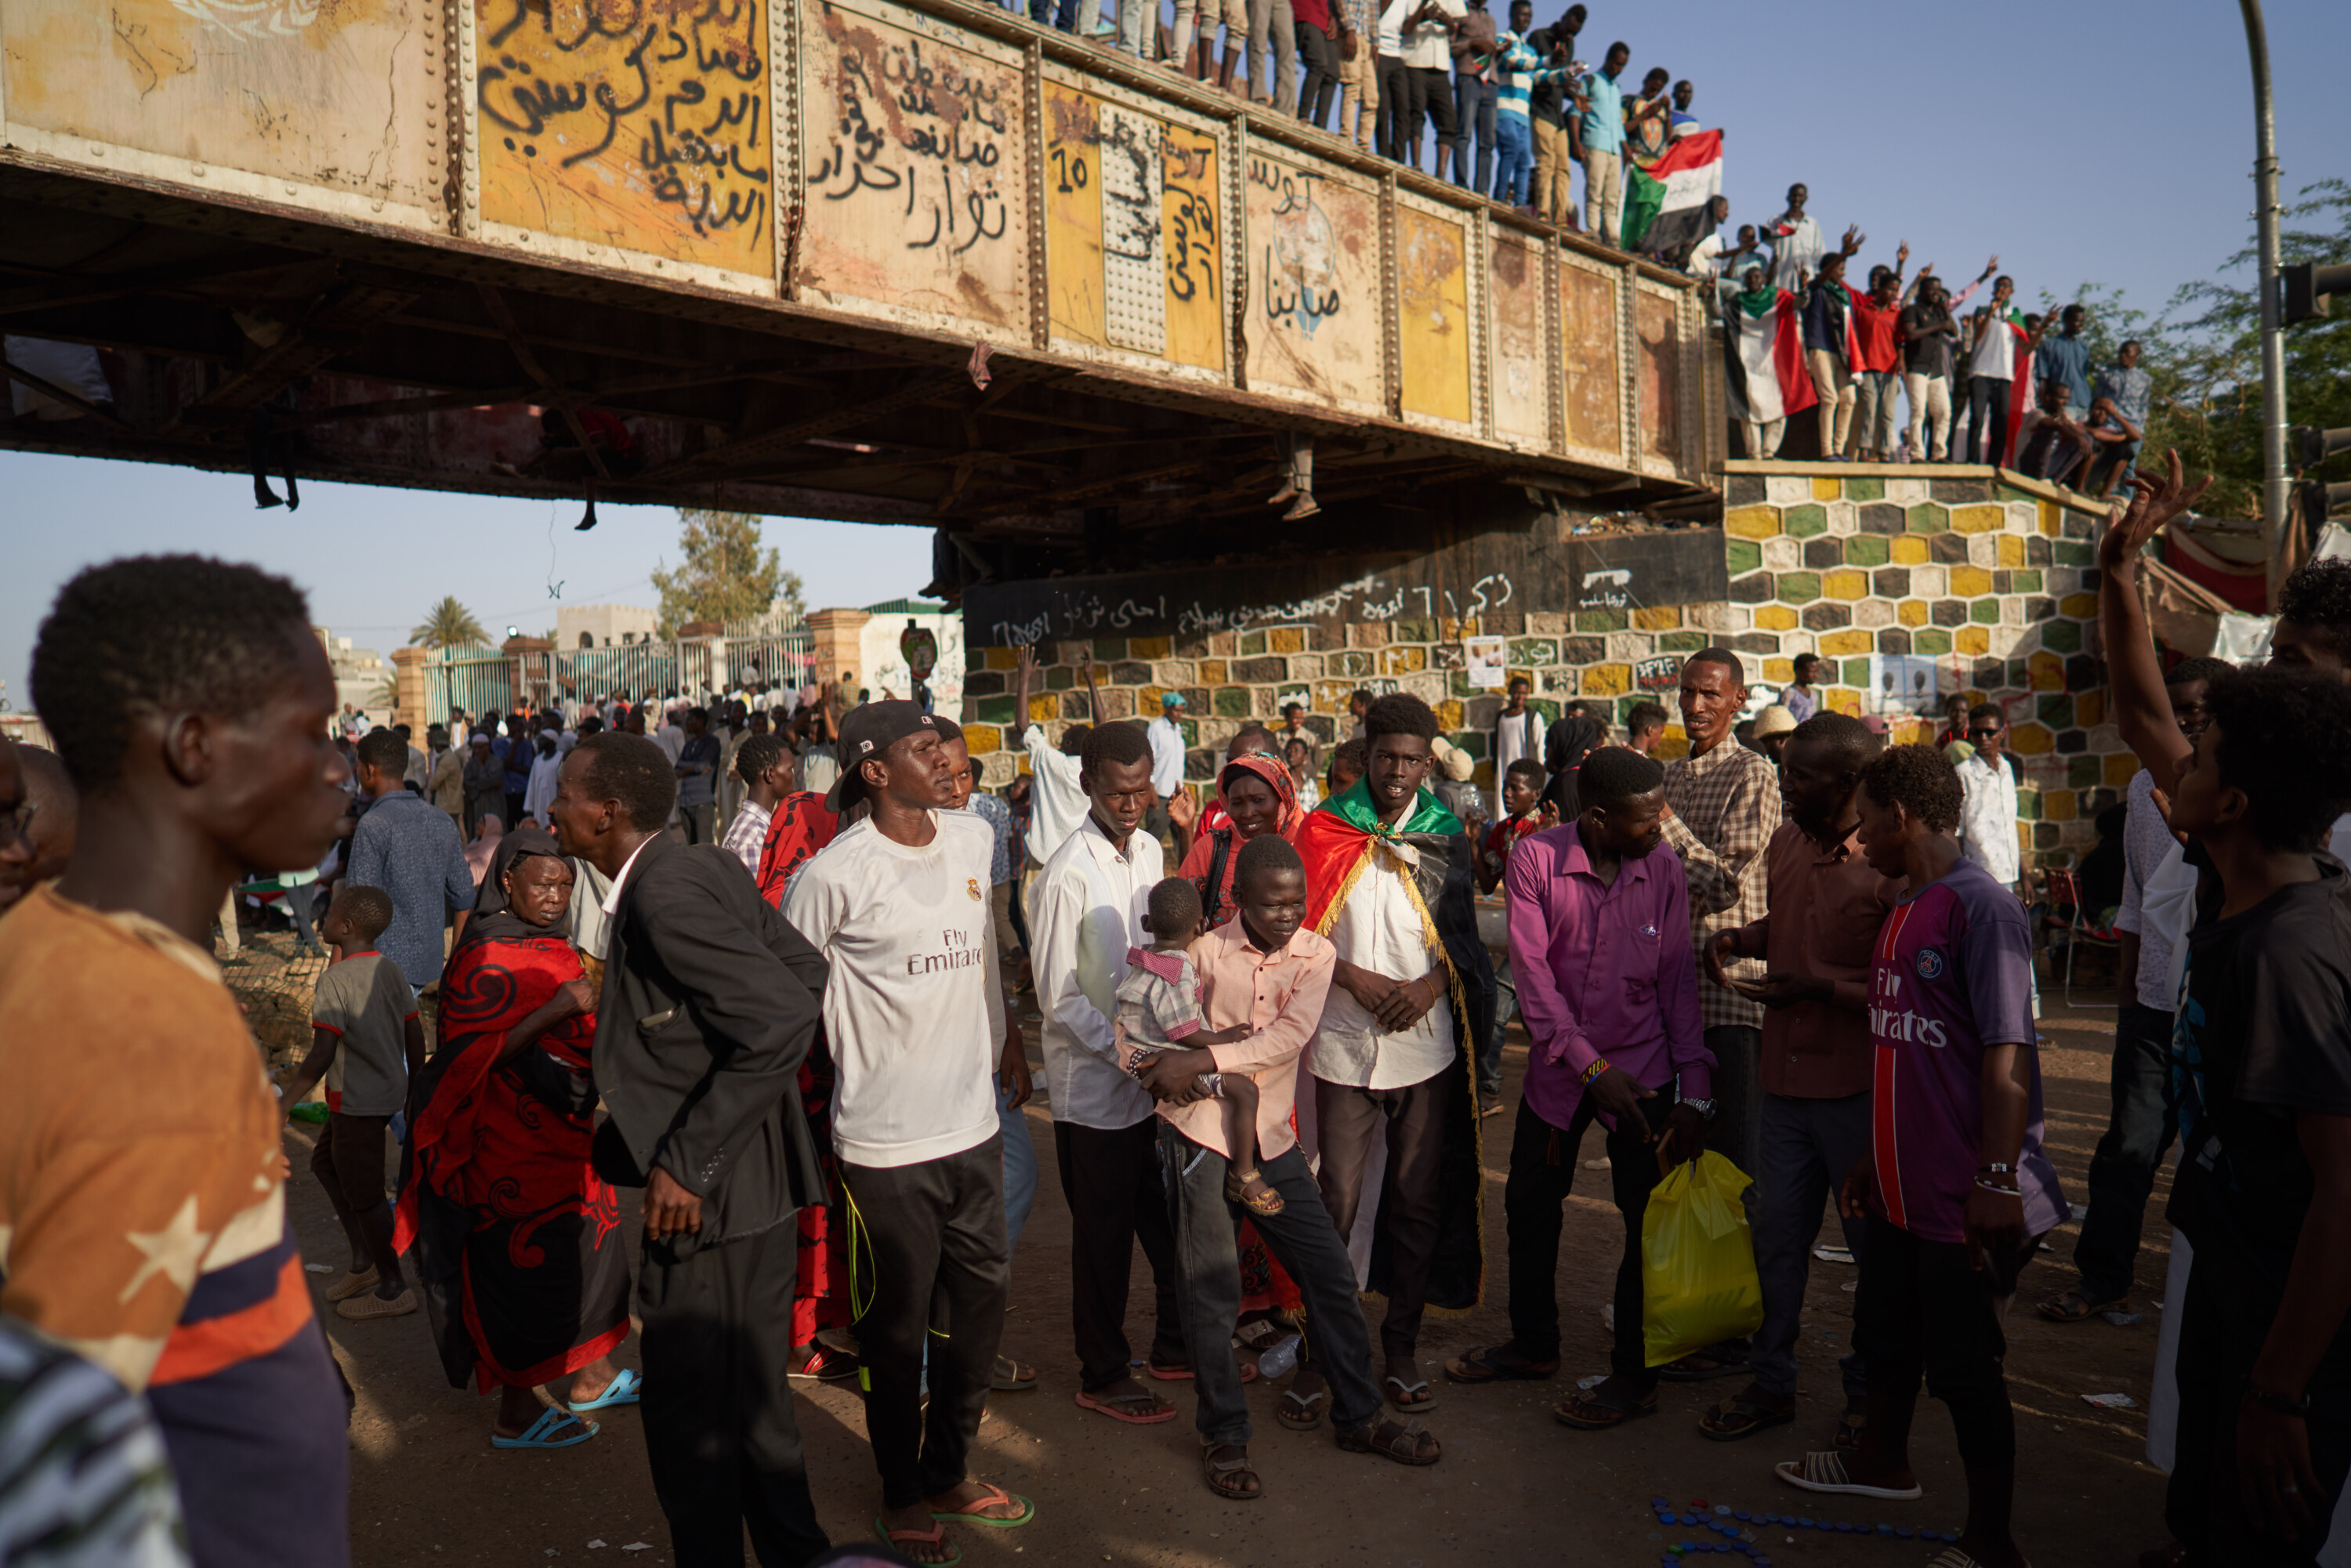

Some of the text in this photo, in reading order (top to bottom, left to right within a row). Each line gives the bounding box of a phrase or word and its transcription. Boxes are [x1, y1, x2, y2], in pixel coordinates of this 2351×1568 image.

[1051, 147, 1088, 194] 10
[943, 929, 967, 947] Fly
[1877, 968, 1901, 1003] Fly
